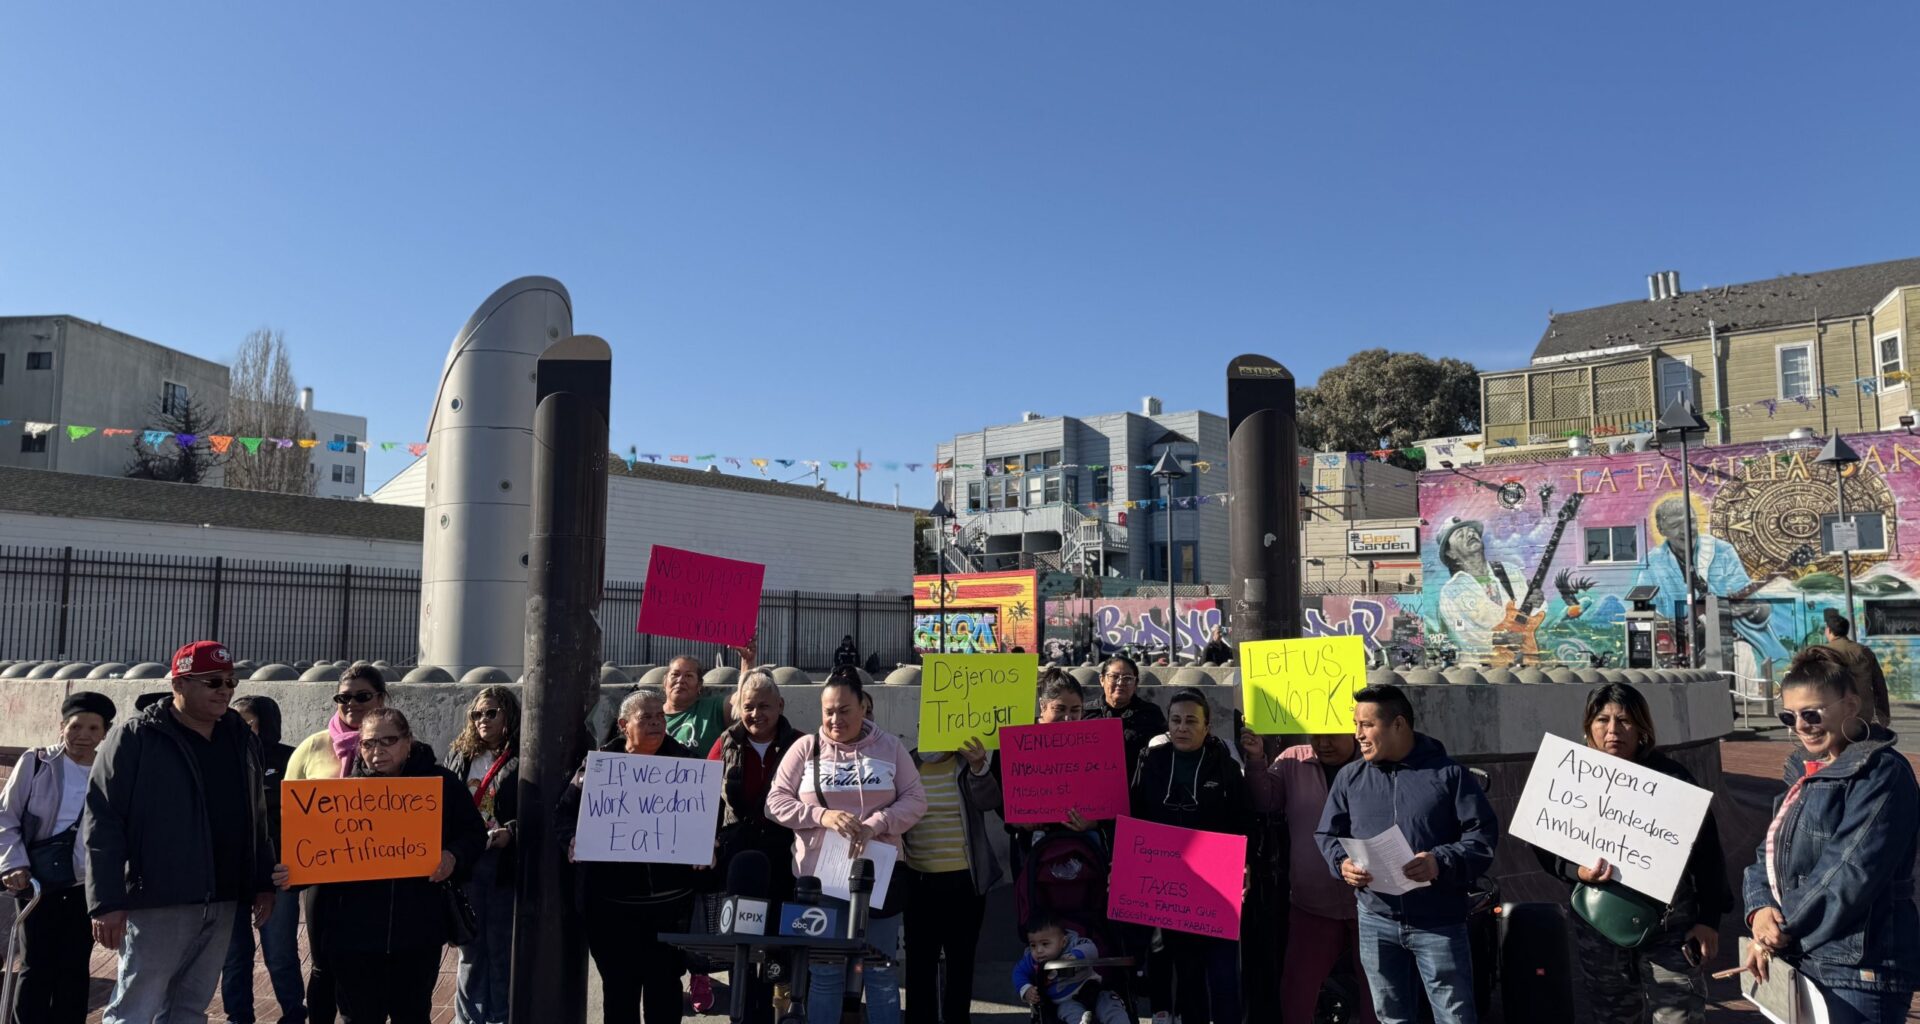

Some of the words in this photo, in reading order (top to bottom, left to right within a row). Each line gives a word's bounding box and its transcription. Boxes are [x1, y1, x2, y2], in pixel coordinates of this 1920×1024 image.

[1573, 466, 1618, 494] LA
[1841, 443, 1920, 477] AN
[1353, 540, 1410, 551] Garden
[1362, 533, 1400, 544] Beer
[654, 549, 681, 580] We
[1248, 643, 1298, 679] Let
[934, 661, 1020, 700] Déjenos
[926, 701, 1018, 736] Trabajar
[1013, 732, 1101, 752] VENDEDORES
[599, 757, 627, 787] If
[1011, 761, 1081, 777] AMBULANTES
[1557, 749, 1638, 794] Apoyen
[1642, 781, 1659, 797] a
[290, 785, 438, 815] Vendedores
[1548, 778, 1588, 809] Los
[1598, 796, 1680, 846] Vendedores
[334, 817, 374, 835] con
[609, 815, 677, 854] Eat!
[1536, 807, 1653, 870] Ambulantes
[296, 836, 428, 869] Certificados
[1133, 835, 1182, 864] Pagamos
[1138, 875, 1190, 899] TAXES
[738, 911, 763, 923] KPIX
[791, 920, 808, 930] abc
[802, 907, 828, 936] 7
